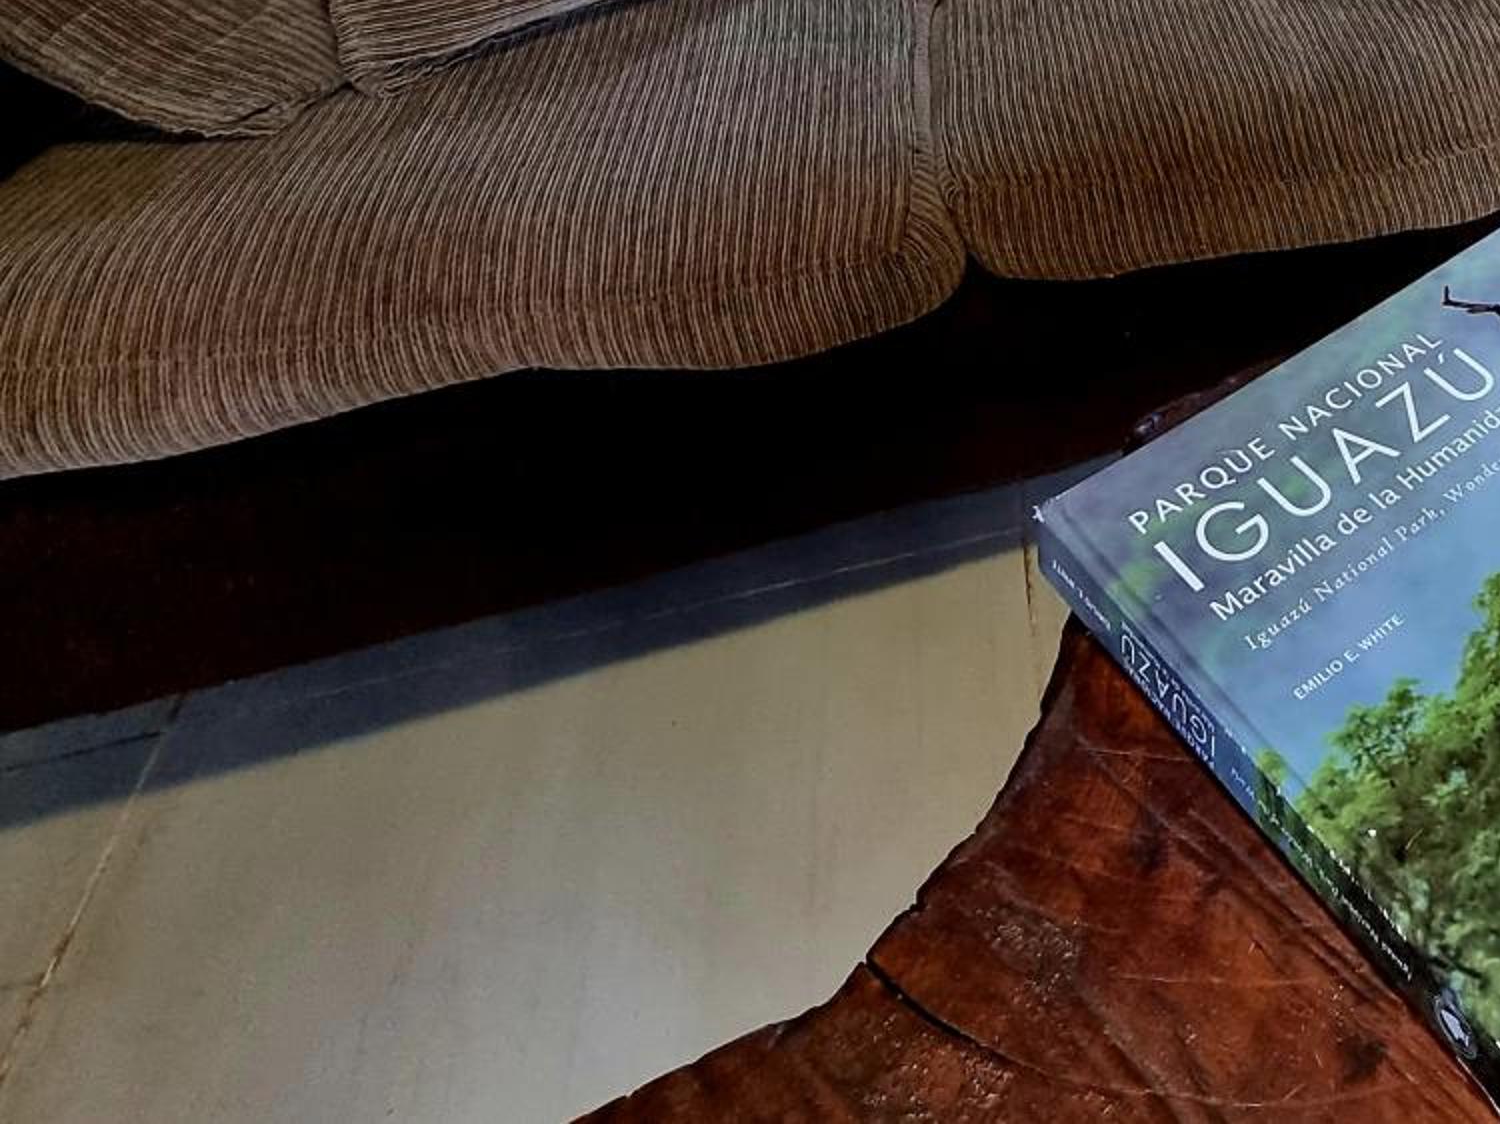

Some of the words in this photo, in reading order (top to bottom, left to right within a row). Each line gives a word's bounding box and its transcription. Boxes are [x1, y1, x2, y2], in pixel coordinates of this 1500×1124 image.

[1128, 436, 1276, 535] PARQUE
[1277, 332, 1444, 441] NACIONAL
[1153, 347, 1496, 593] IGUAZÚ
[1209, 532, 1337, 621] Maravilla
[1337, 507, 1374, 536] de
[1369, 488, 1400, 510] la
[1244, 597, 1313, 651] Iguazú
[1313, 536, 1394, 603] National
[1394, 507, 1446, 543] Park,
[1292, 658, 1344, 701] EMILIO
[1357, 612, 1405, 652] WHITE
